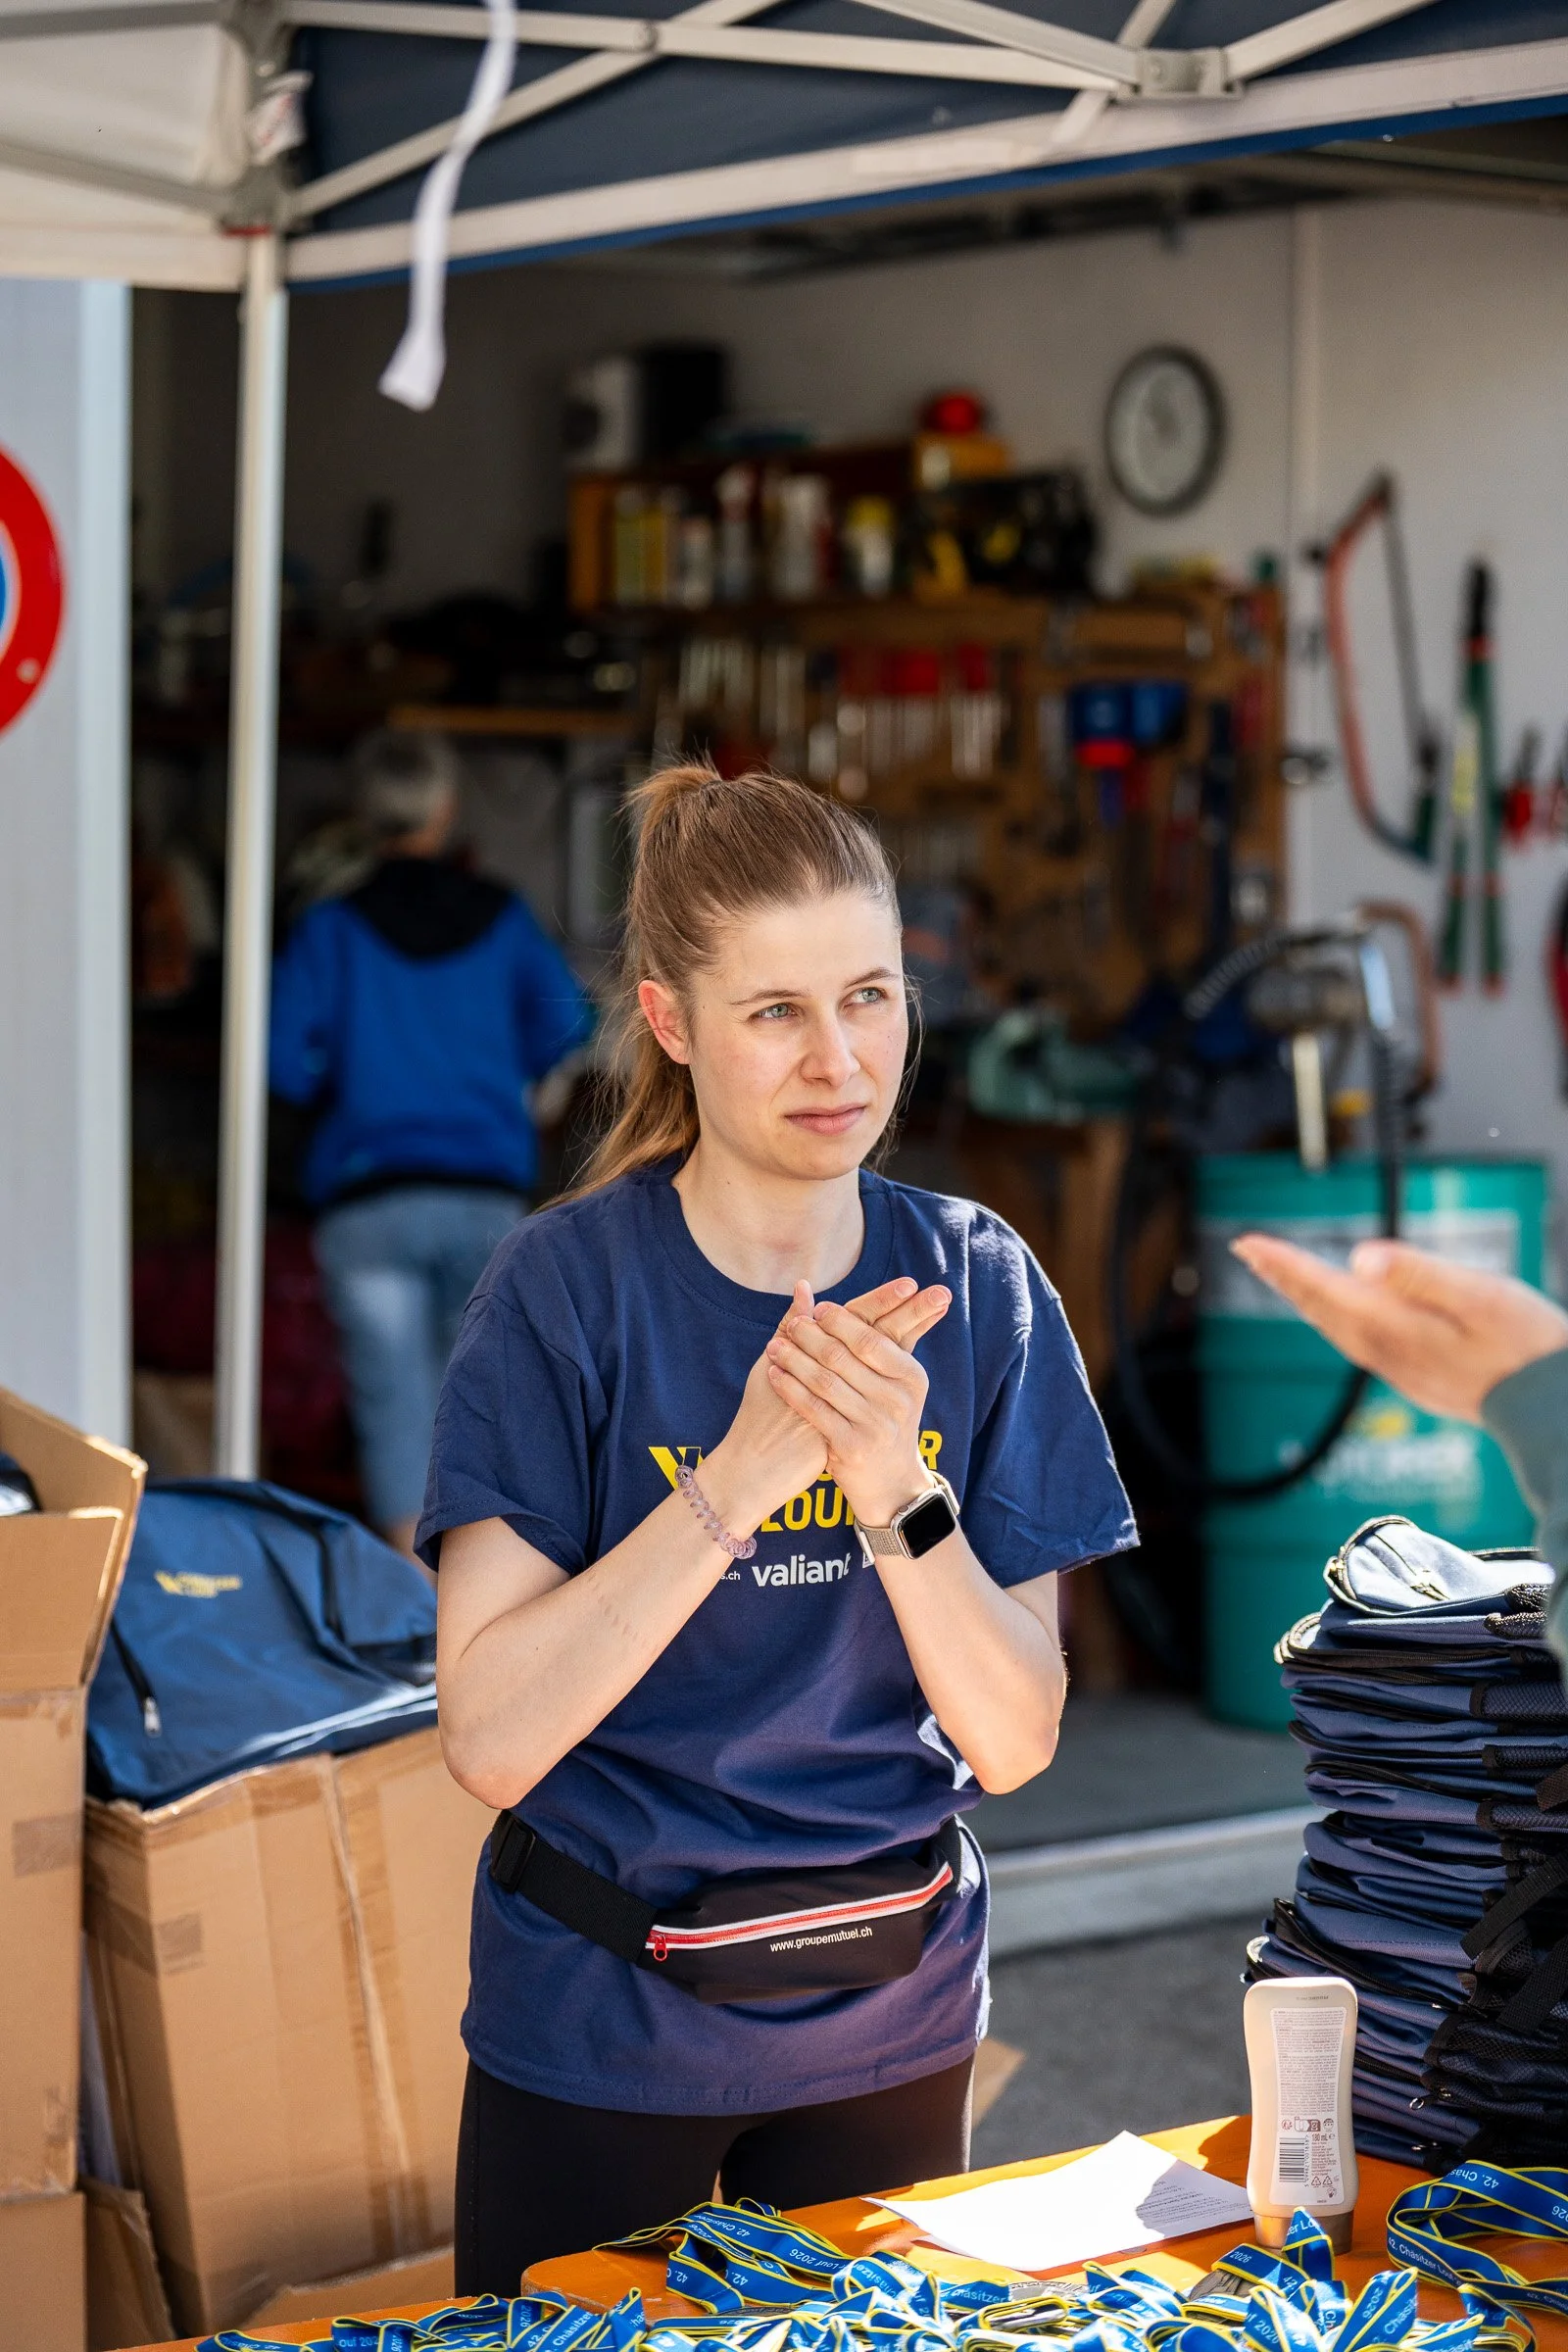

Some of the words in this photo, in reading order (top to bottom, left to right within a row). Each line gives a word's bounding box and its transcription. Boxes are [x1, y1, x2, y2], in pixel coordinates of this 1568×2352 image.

[752, 1552, 852, 1588] valiant
[770, 1926, 873, 1953] www.groupemutuel.ch
[1482, 2174, 1499, 2189] 42.
[737, 2229, 751, 2237] 42.
[789, 2248, 816, 2265] 2026
[1229, 2250, 1252, 2264] 2026
[814, 2260, 839, 2270] Louf
[674, 2270, 688, 2283] 42.
[731, 2271, 749, 2286] 42.
[1362, 2287, 1384, 2319] 2026
[519, 2305, 532, 2328] 2026
[338, 2336, 357, 2348] ouf
[361, 2335, 379, 2347] 202
